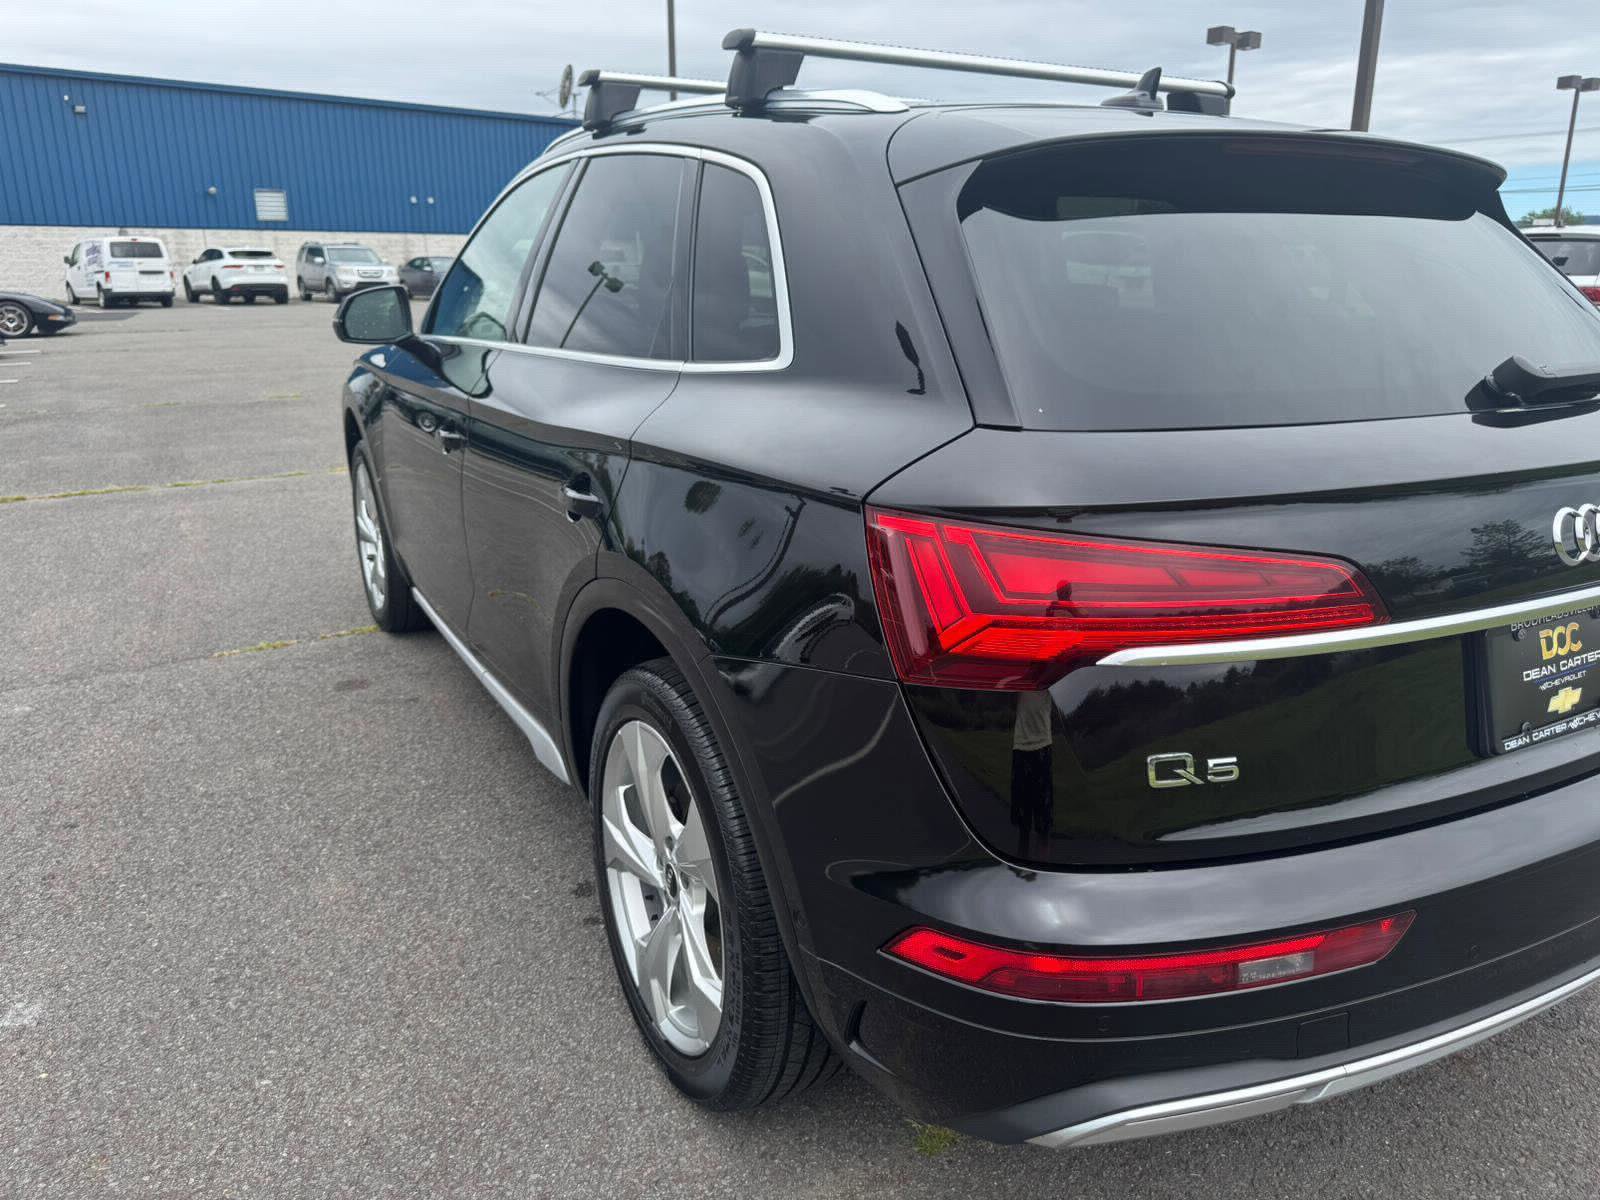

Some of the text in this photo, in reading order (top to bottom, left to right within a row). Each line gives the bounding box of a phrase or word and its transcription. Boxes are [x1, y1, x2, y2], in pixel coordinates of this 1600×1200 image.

[1539, 622, 1582, 660] DOC
[1523, 650, 1600, 681] DEAN CARTER
[1504, 734, 1531, 750] DEAN
[1532, 722, 1567, 741] CARTER
[1147, 752, 1240, 788] Q5
